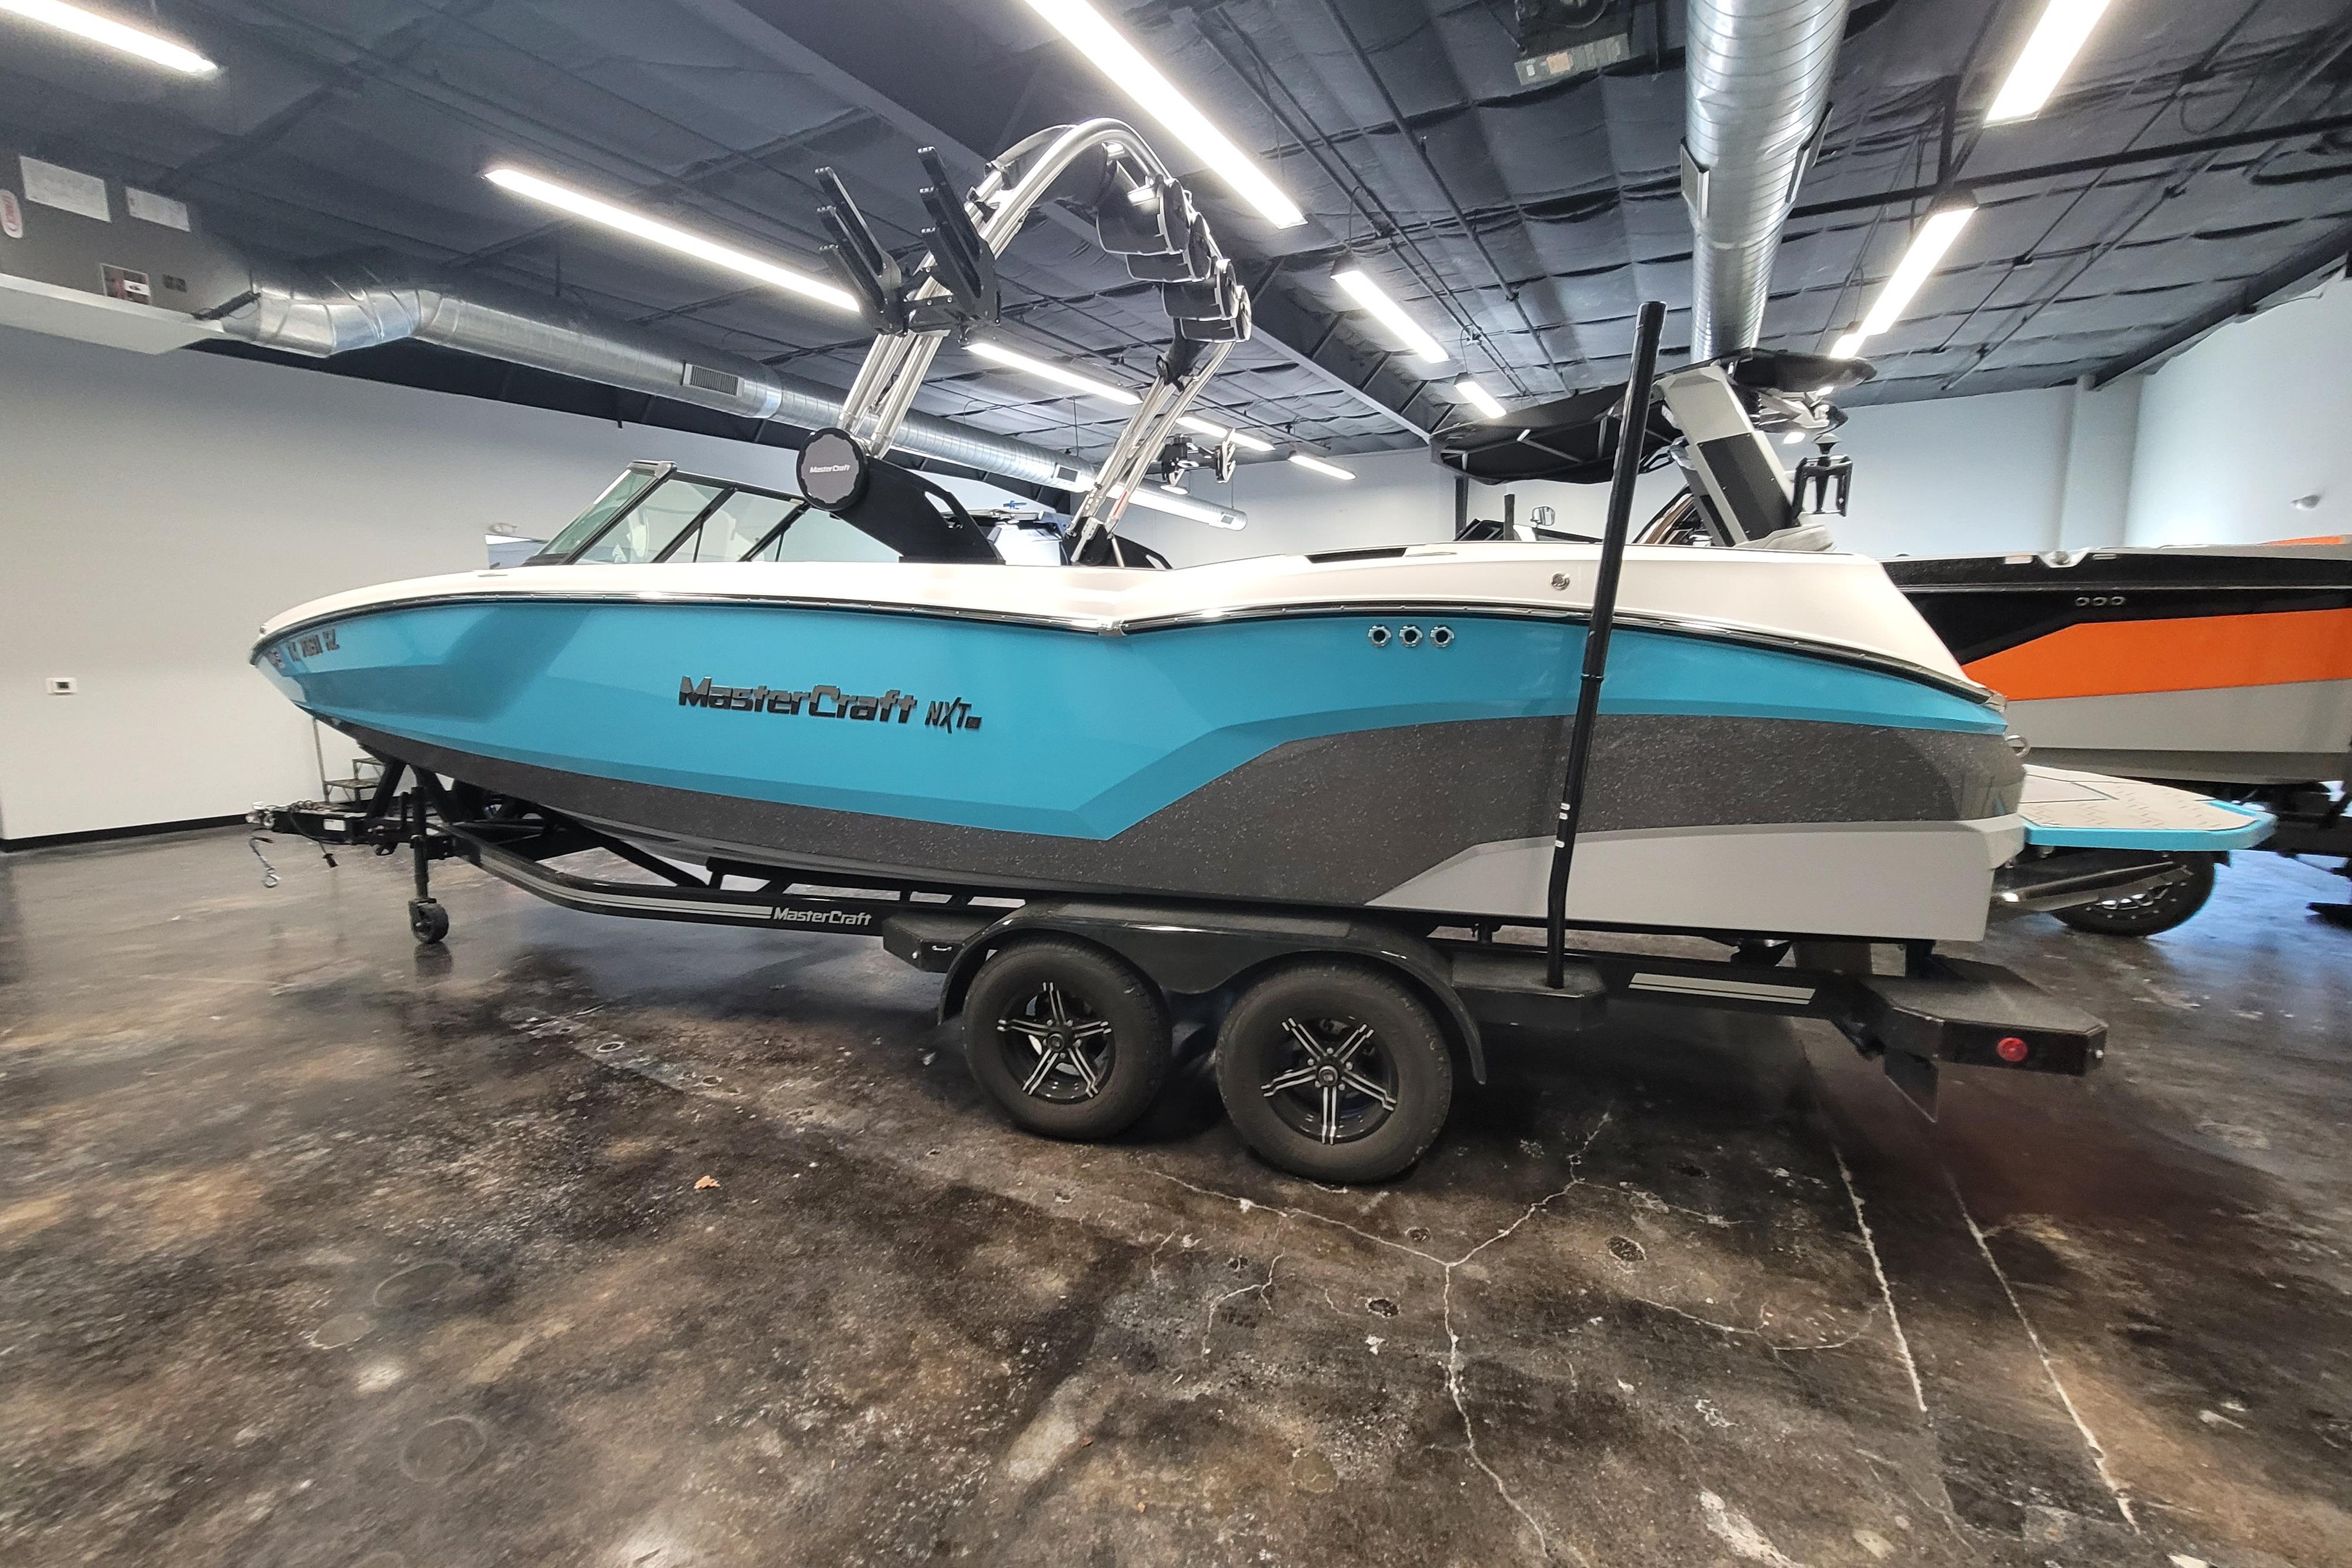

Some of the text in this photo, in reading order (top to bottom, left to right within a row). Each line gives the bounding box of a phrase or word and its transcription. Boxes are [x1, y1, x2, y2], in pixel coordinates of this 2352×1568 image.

[810, 464, 850, 473] MasterCraft
[679, 676, 917, 723] MasterCraft
[774, 907, 871, 925] MasterCraft
